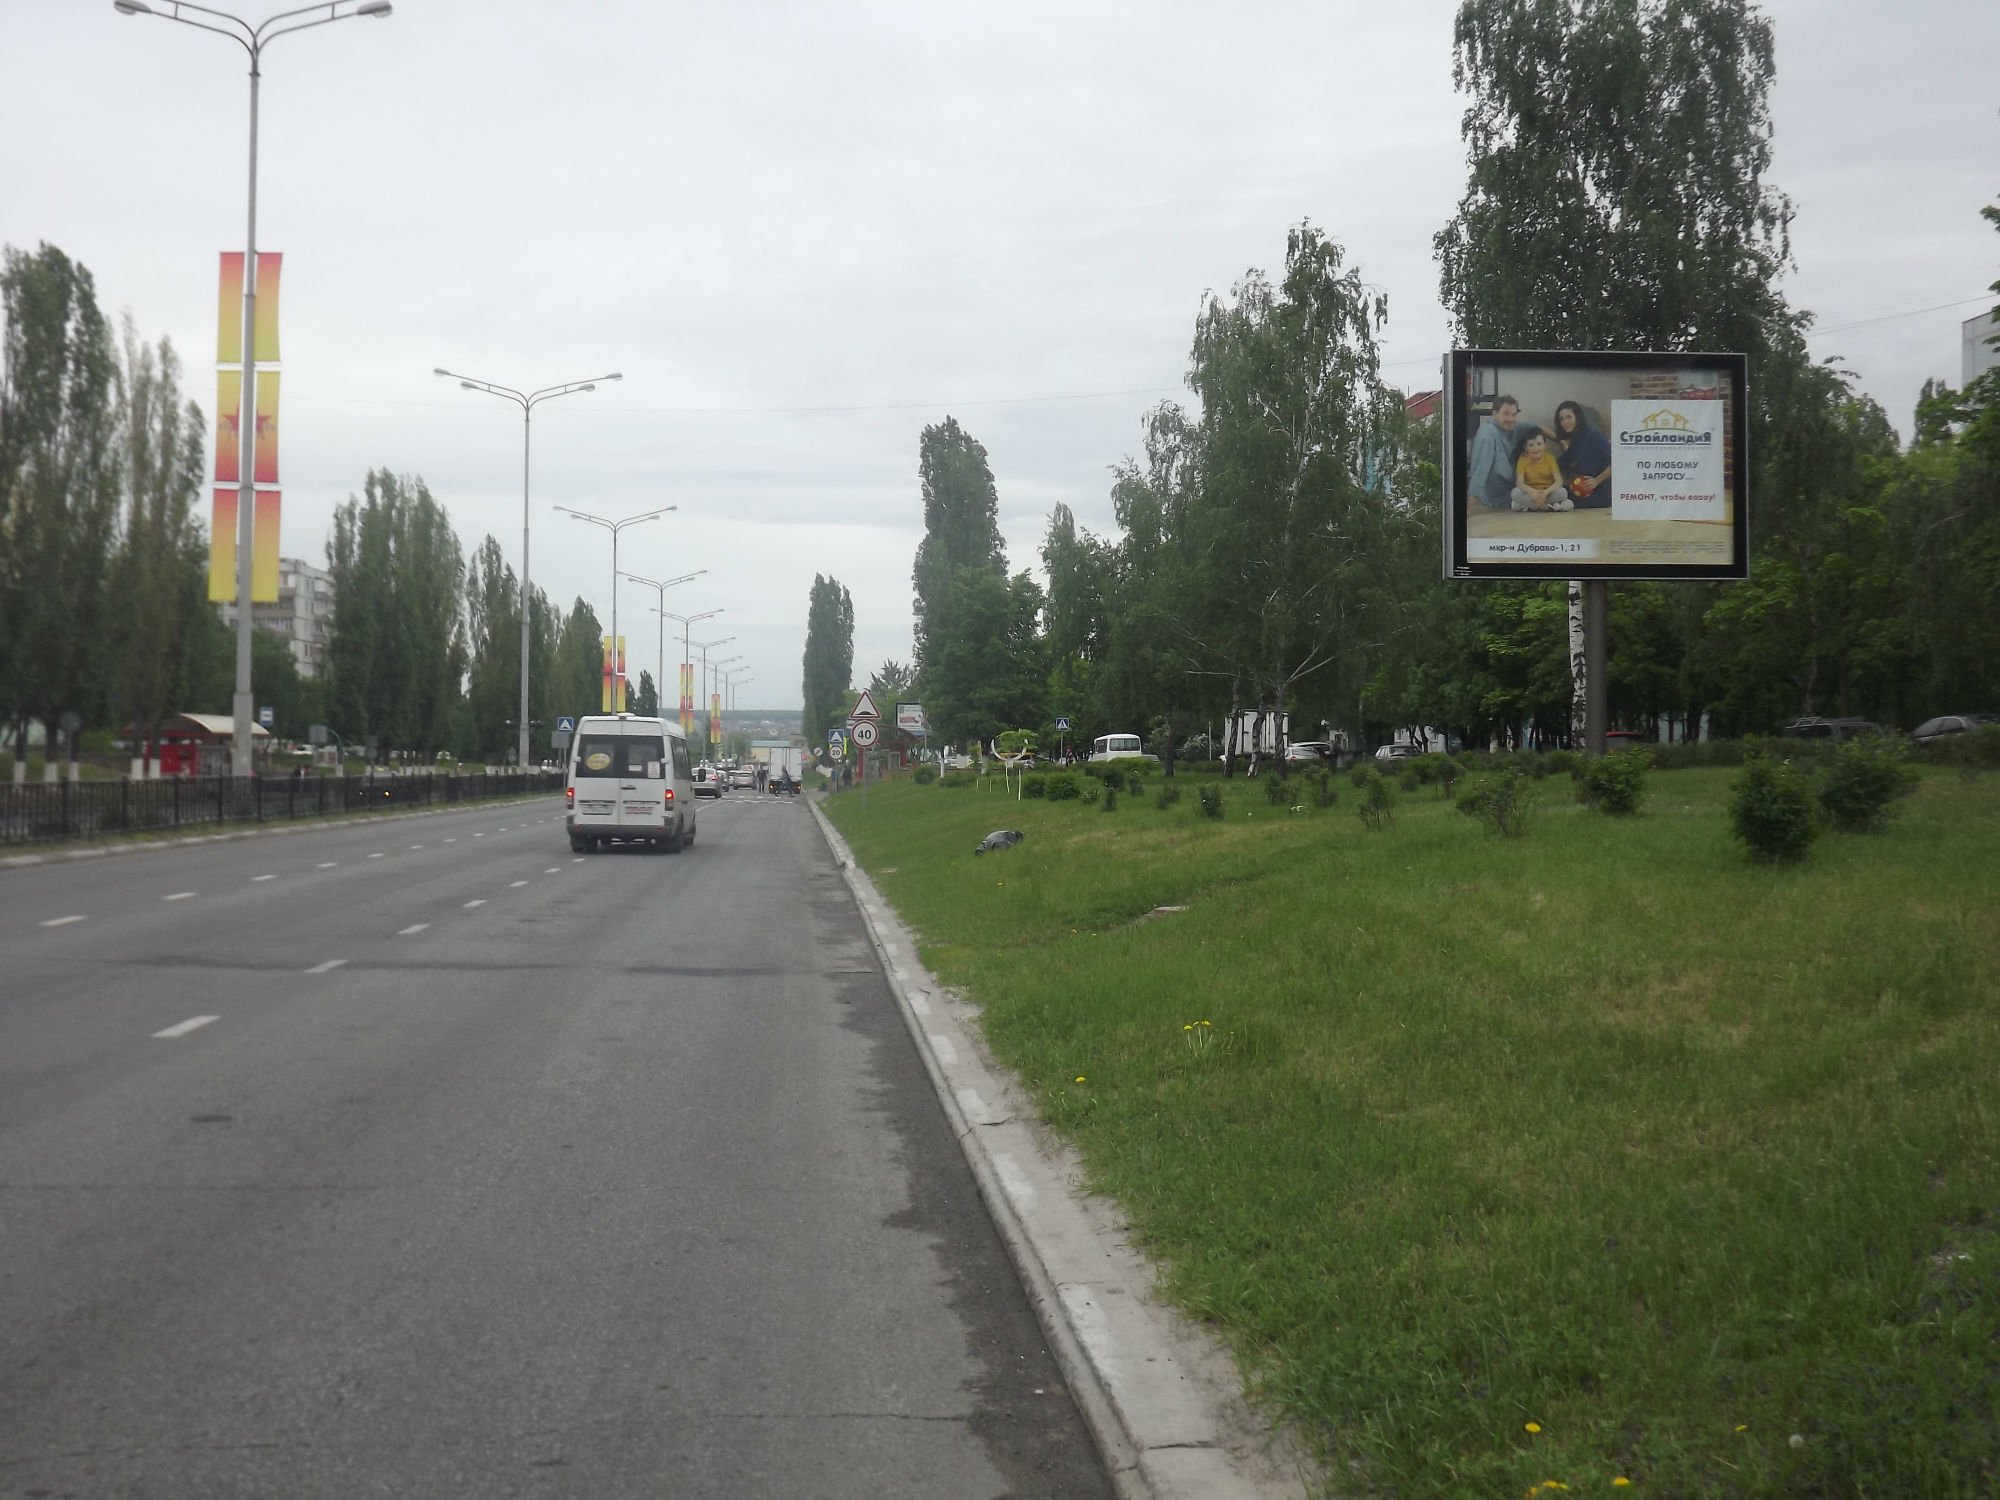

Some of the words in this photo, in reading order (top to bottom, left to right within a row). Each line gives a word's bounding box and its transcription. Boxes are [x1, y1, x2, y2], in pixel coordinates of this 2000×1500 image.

[1637, 461, 1651, 469] ПО
[1654, 461, 1699, 469] ЛЮБОМУ
[1620, 493, 1657, 501] РЕМОНТ,
[1488, 544, 1515, 552] мкр-н
[1570, 543, 1581, 552] 21
[857, 729, 872, 740] 40
